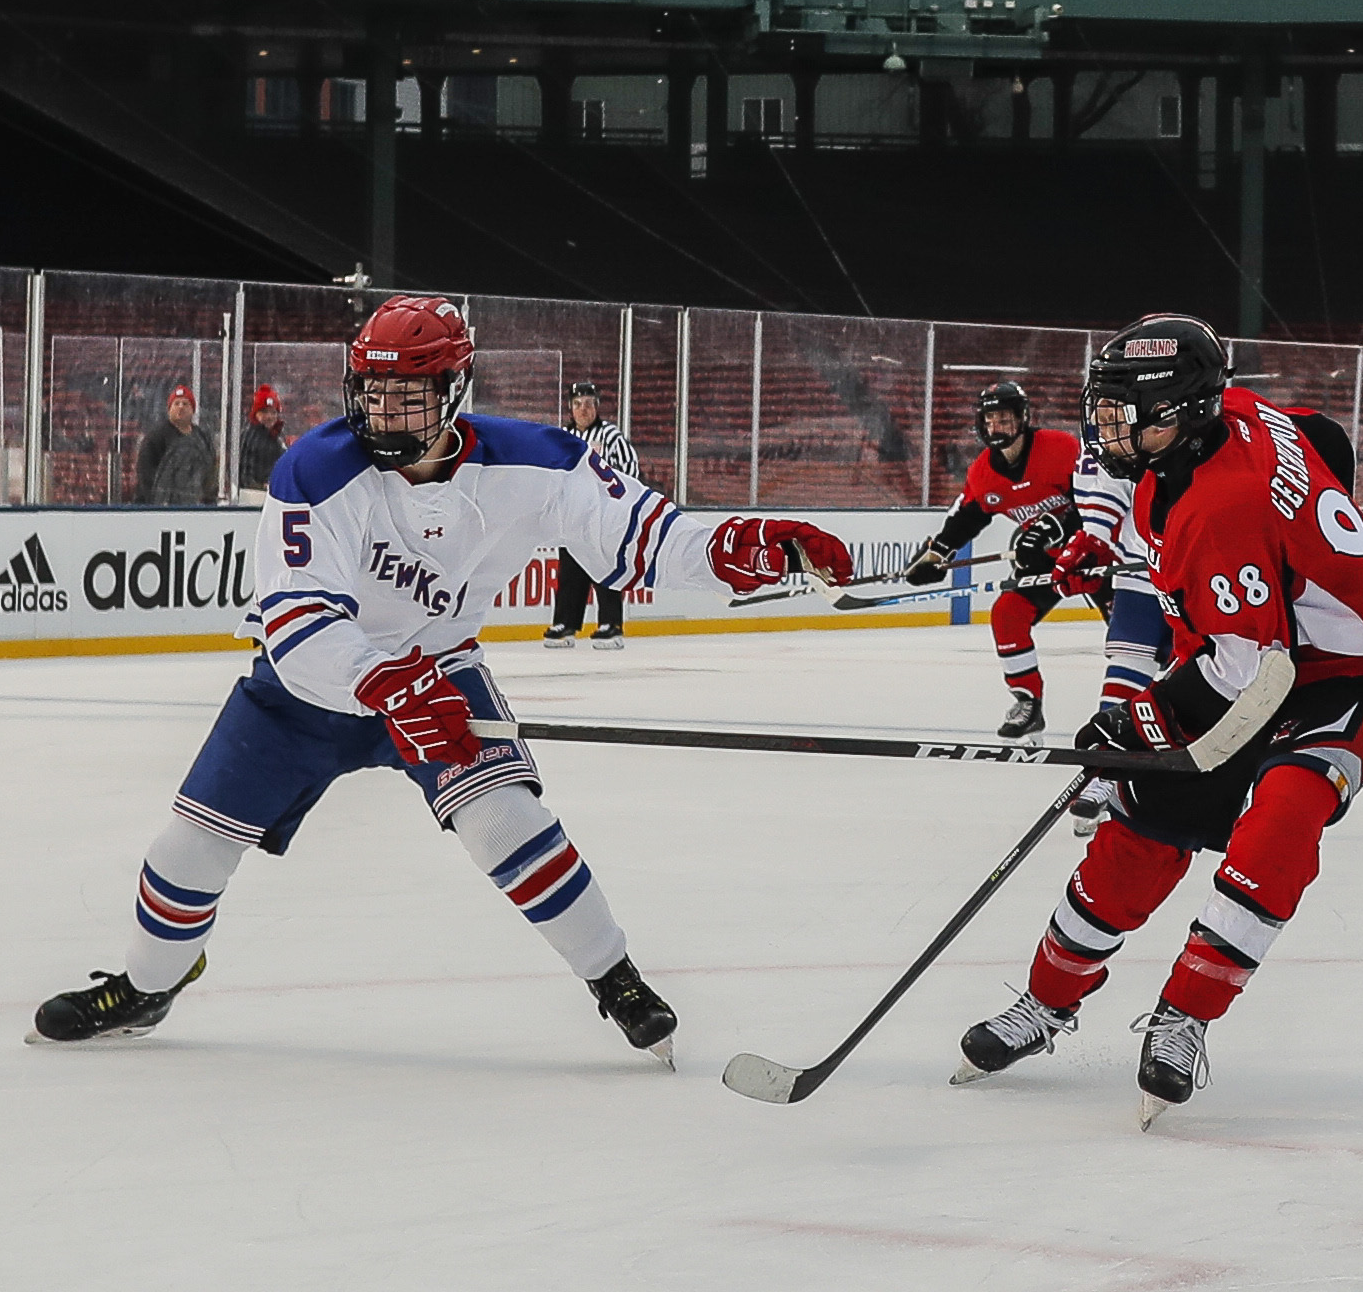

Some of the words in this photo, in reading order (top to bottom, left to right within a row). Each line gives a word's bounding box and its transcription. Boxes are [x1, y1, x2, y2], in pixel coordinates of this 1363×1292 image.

[1137, 370, 1174, 382] BAUER
[587, 448, 627, 501] 5
[281, 509, 313, 568] 5
[83, 530, 260, 609] adiclu
[877, 541, 924, 585] VODK
[1210, 564, 1270, 615] 88
[914, 742, 1053, 765] CCM
[1223, 864, 1260, 890] CCM
